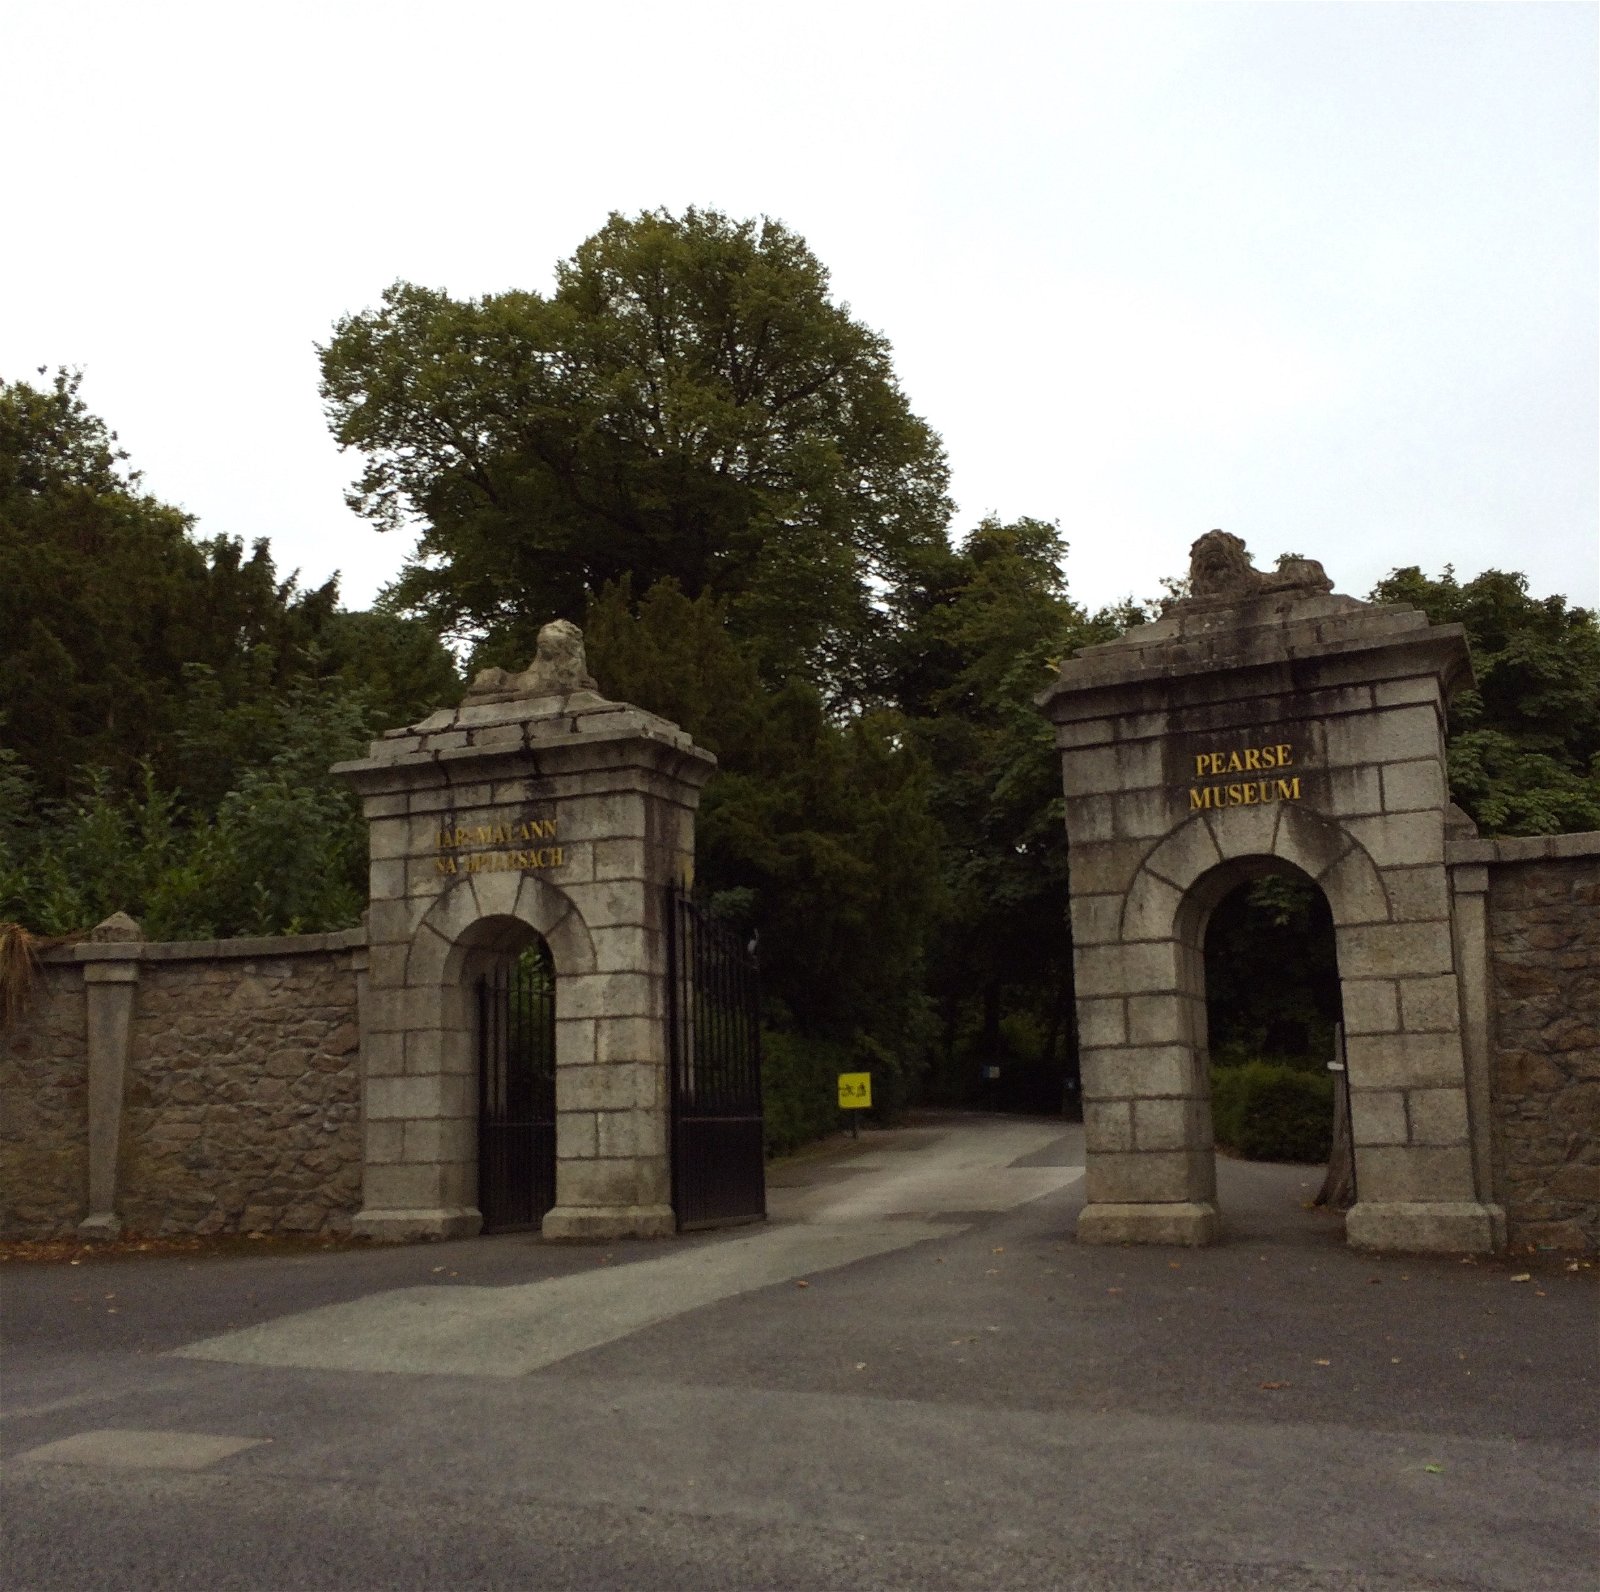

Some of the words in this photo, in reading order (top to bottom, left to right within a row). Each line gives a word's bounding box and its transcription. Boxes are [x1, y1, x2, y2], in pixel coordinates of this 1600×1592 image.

[1195, 744, 1293, 776] PEARSE
[1189, 777, 1301, 810] MUSEUM
[434, 819, 557, 848] IARMALANN
